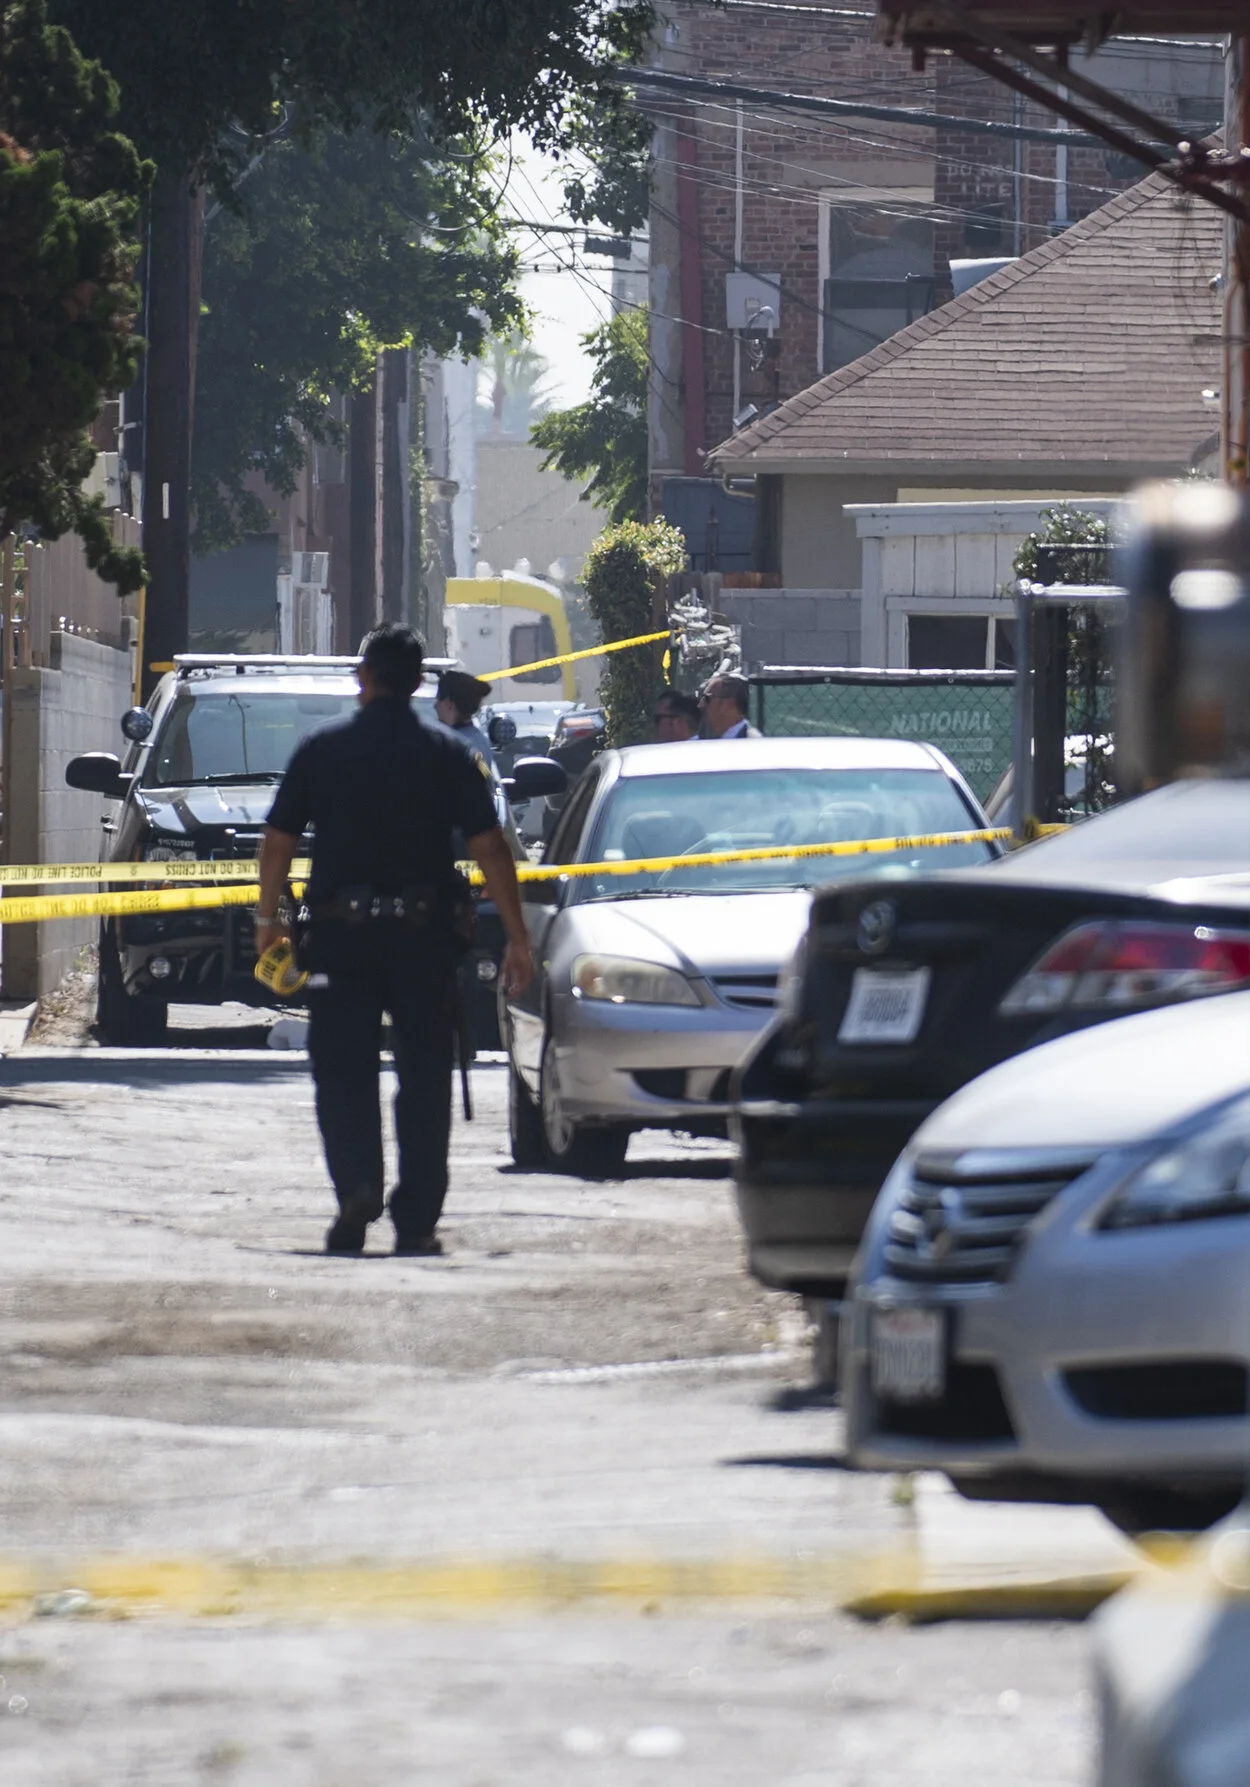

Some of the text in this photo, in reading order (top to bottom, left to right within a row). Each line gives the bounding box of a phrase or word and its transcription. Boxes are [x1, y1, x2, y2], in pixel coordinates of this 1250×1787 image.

[889, 710, 991, 734] NATIONAL
[48, 866, 66, 879] LINE
[70, 865, 103, 878] POLICE
[165, 863, 196, 877] CROSS
[199, 863, 217, 876] NOT
[220, 863, 232, 875] DO
